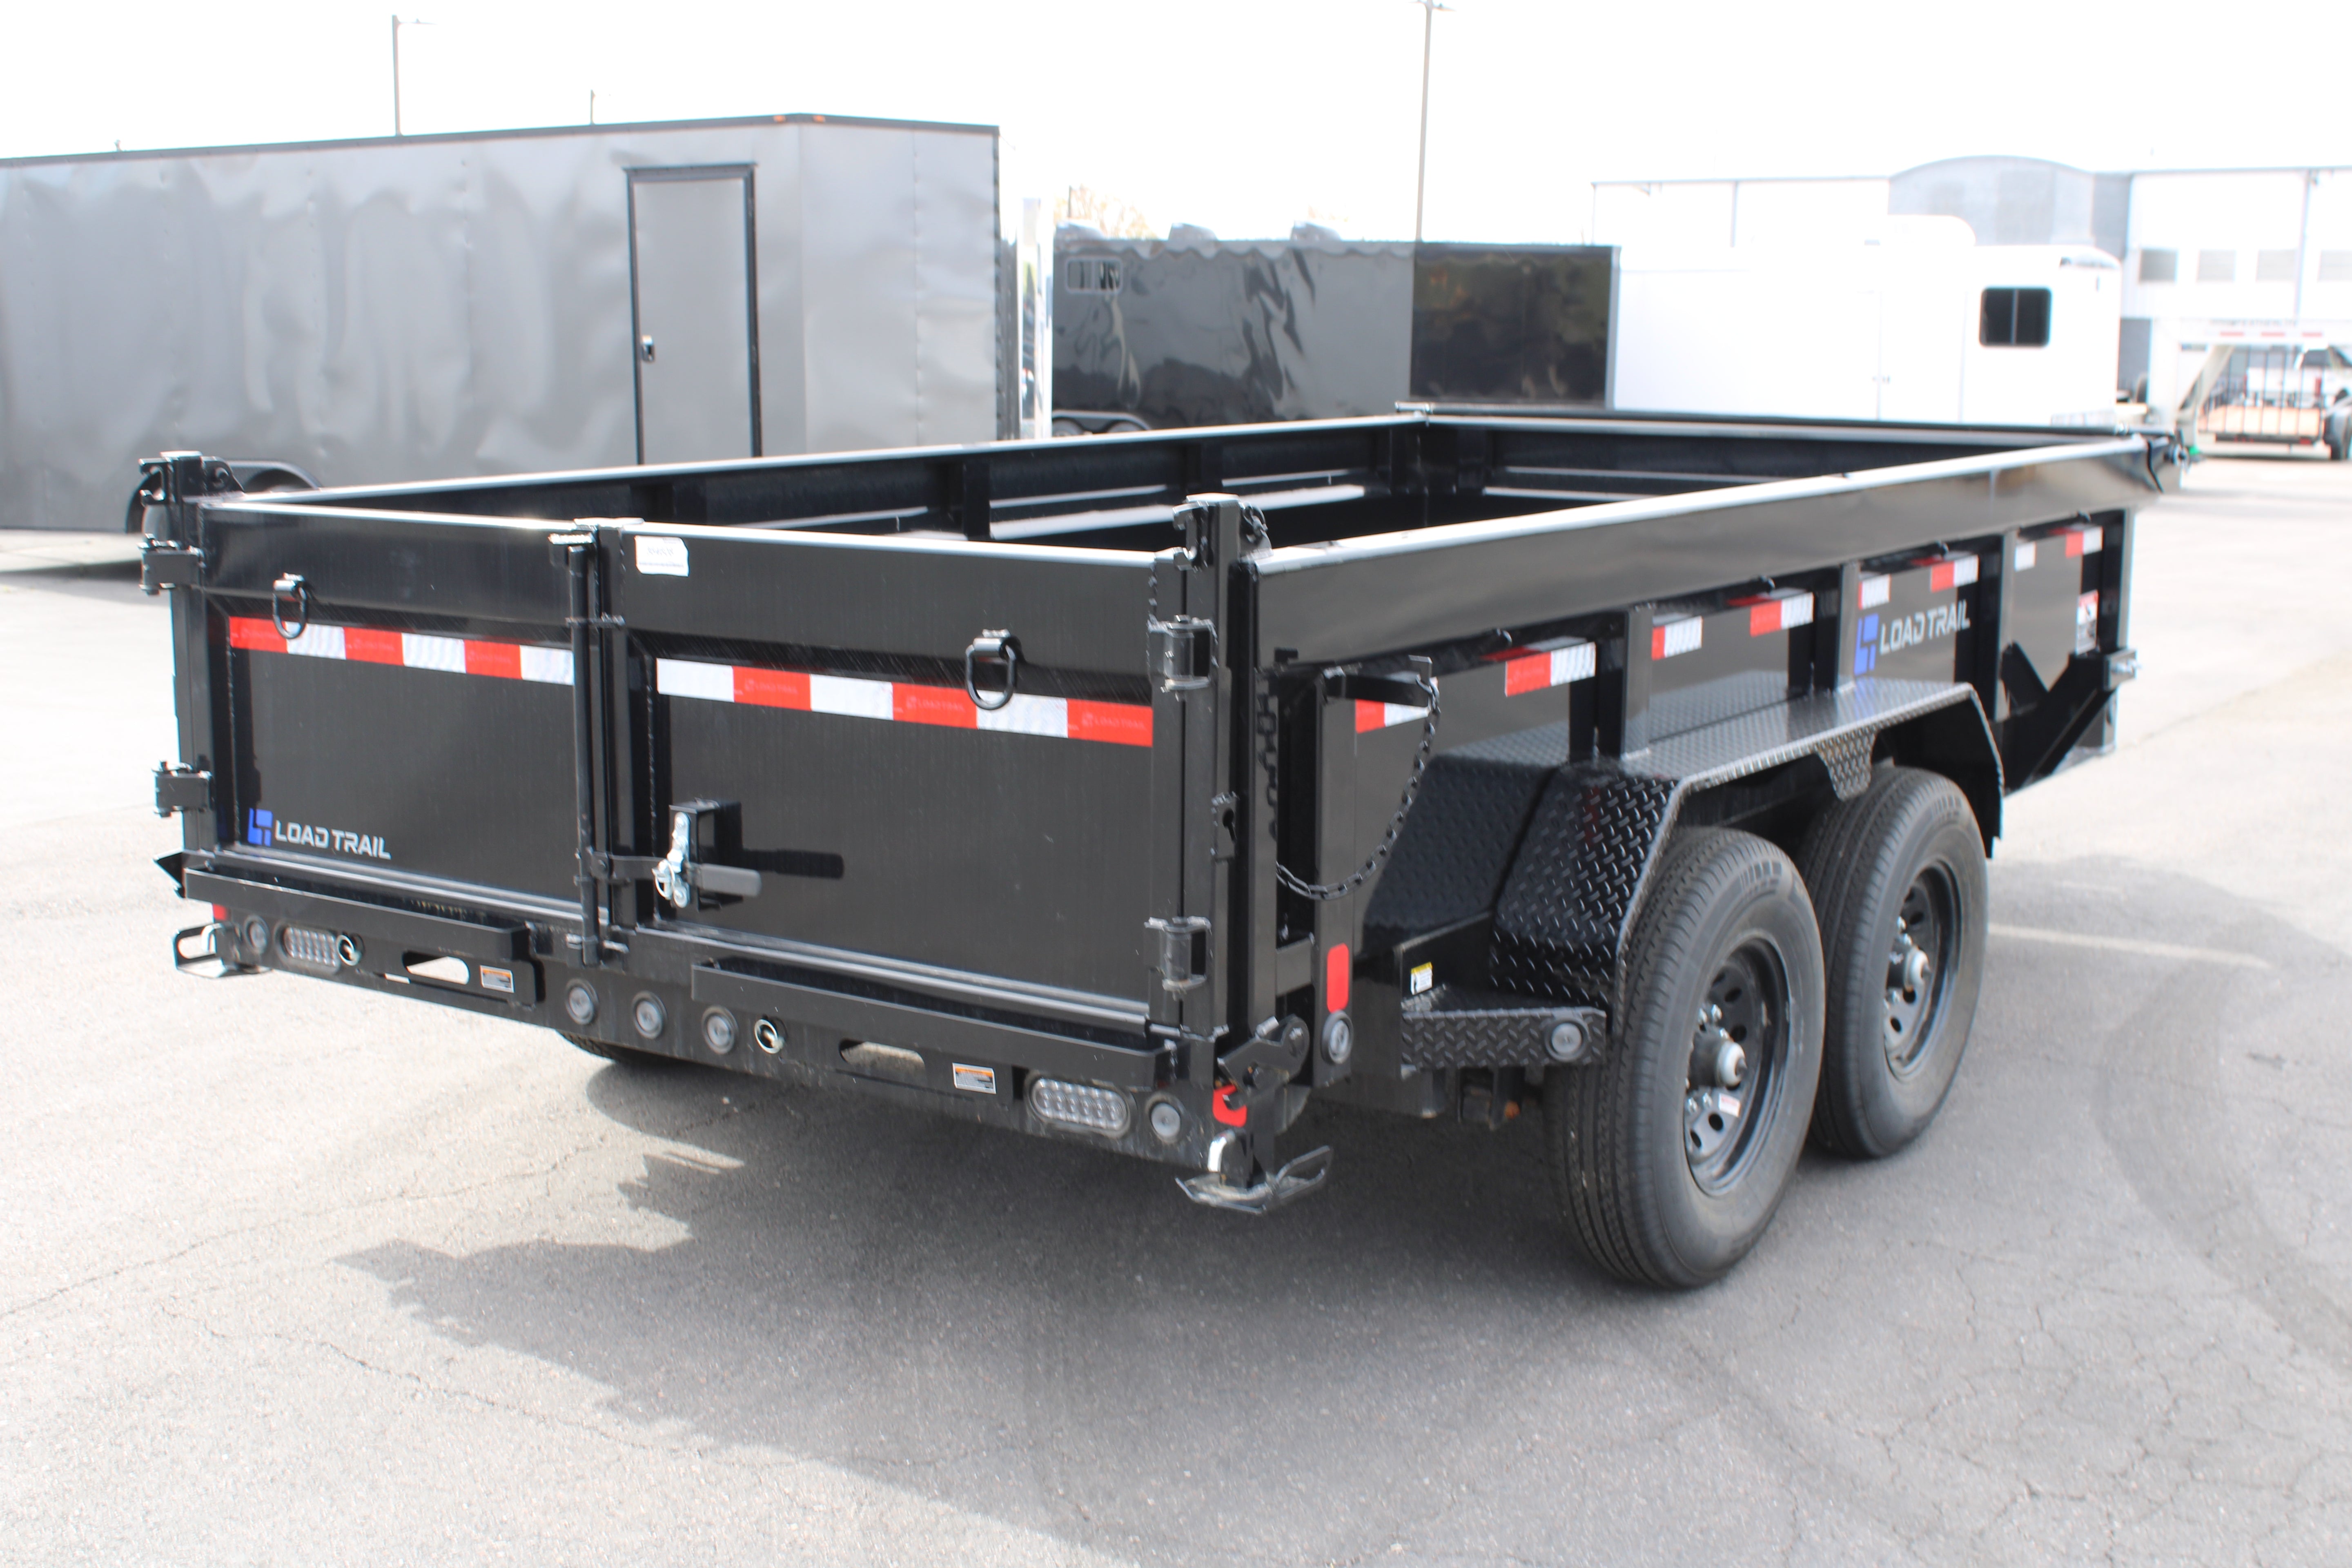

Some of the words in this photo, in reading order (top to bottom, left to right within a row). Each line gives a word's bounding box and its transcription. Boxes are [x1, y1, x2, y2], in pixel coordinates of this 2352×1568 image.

[1880, 611, 1926, 655] LOAD
[1927, 599, 1971, 639] TRAIL
[275, 820, 330, 849] LOAD
[331, 829, 392, 860] TRAIL
